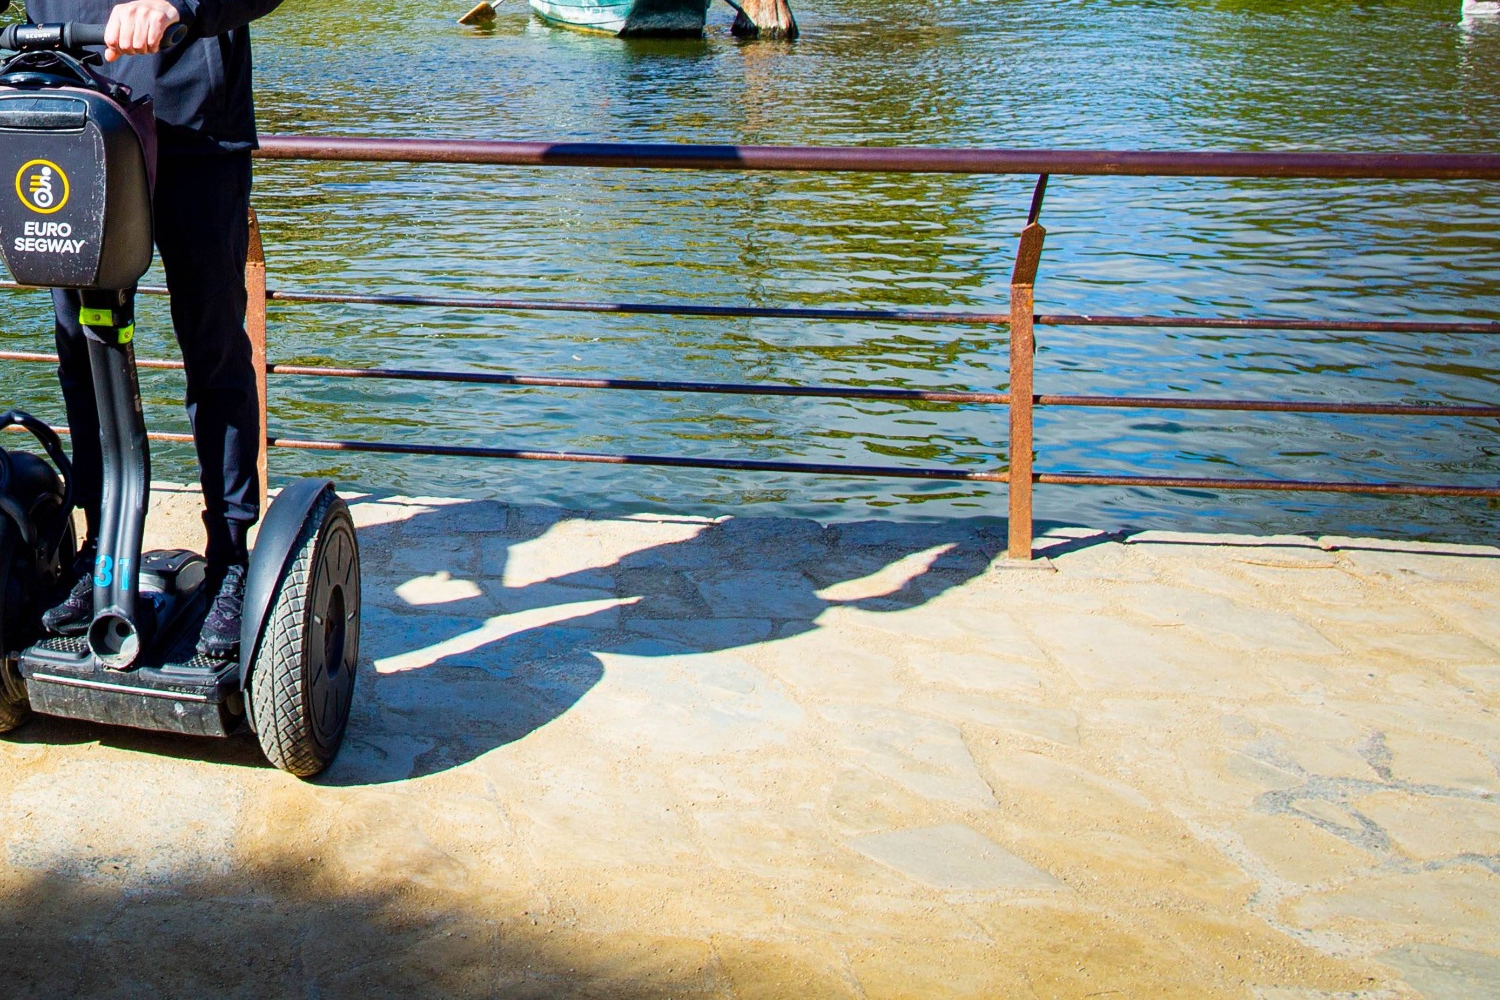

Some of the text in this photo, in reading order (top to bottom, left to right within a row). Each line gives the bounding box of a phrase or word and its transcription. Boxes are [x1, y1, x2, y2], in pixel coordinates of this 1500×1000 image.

[24, 221, 71, 237] EURO
[14, 237, 85, 253] SEGWAY
[93, 554, 131, 591] 31
